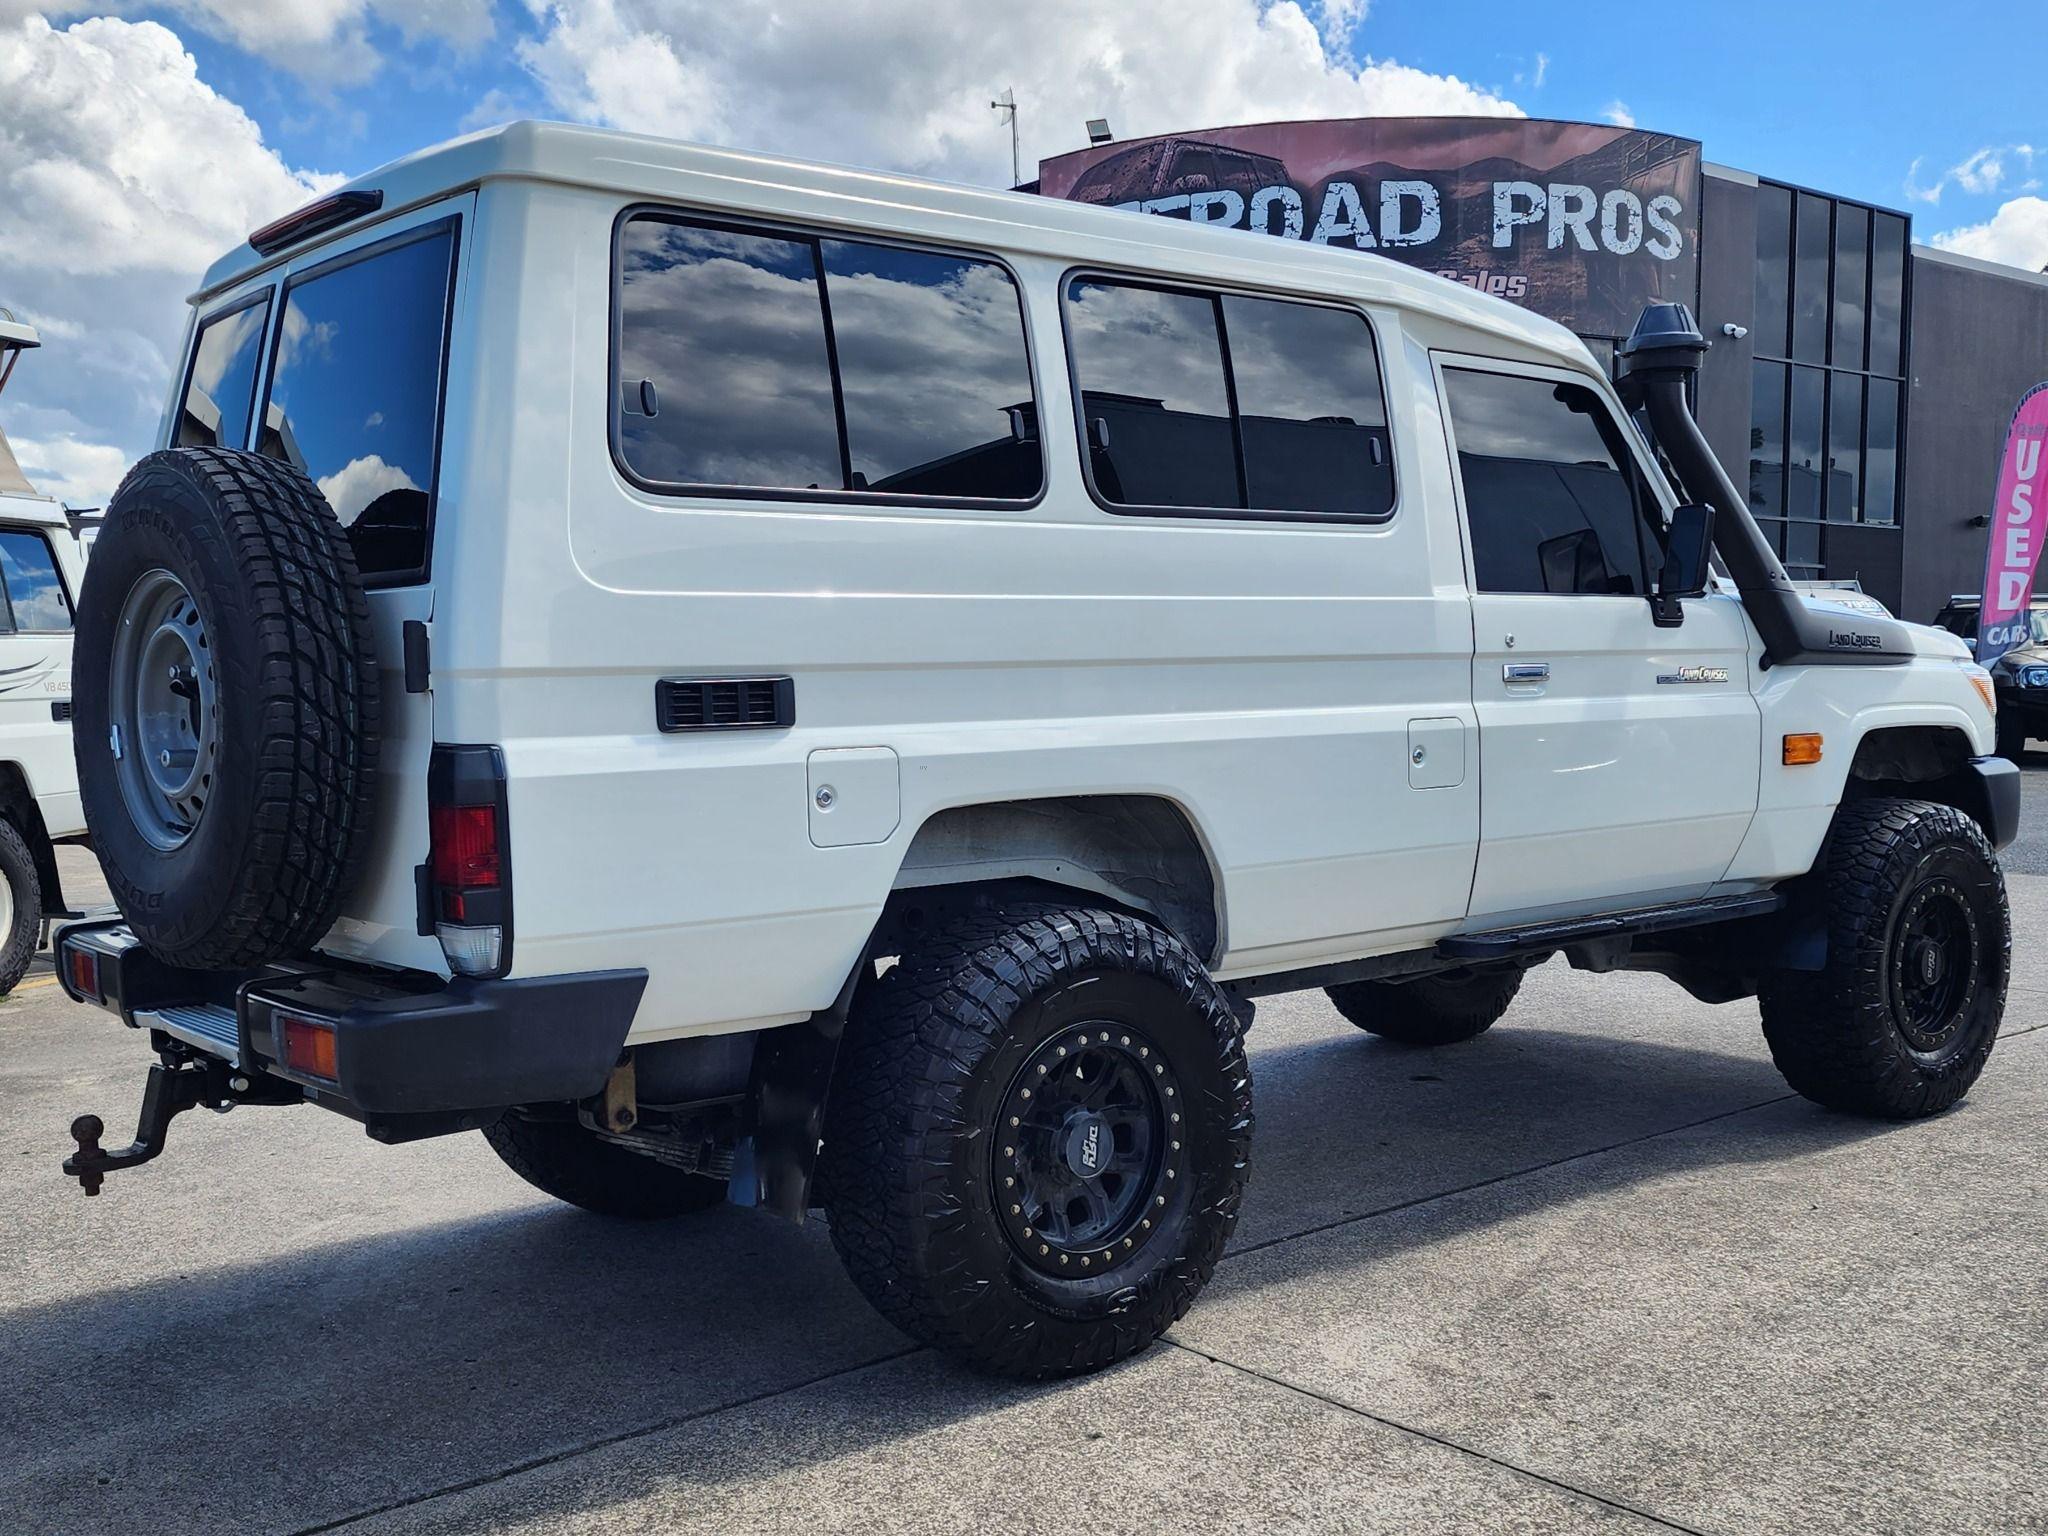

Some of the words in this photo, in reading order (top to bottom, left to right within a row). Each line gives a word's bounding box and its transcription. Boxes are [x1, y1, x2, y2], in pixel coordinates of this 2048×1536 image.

[1112, 181, 1441, 249] ROAD
[1491, 181, 1682, 261] PROS
[1998, 438, 2041, 611] USED
[1986, 625, 2028, 647] CARS
